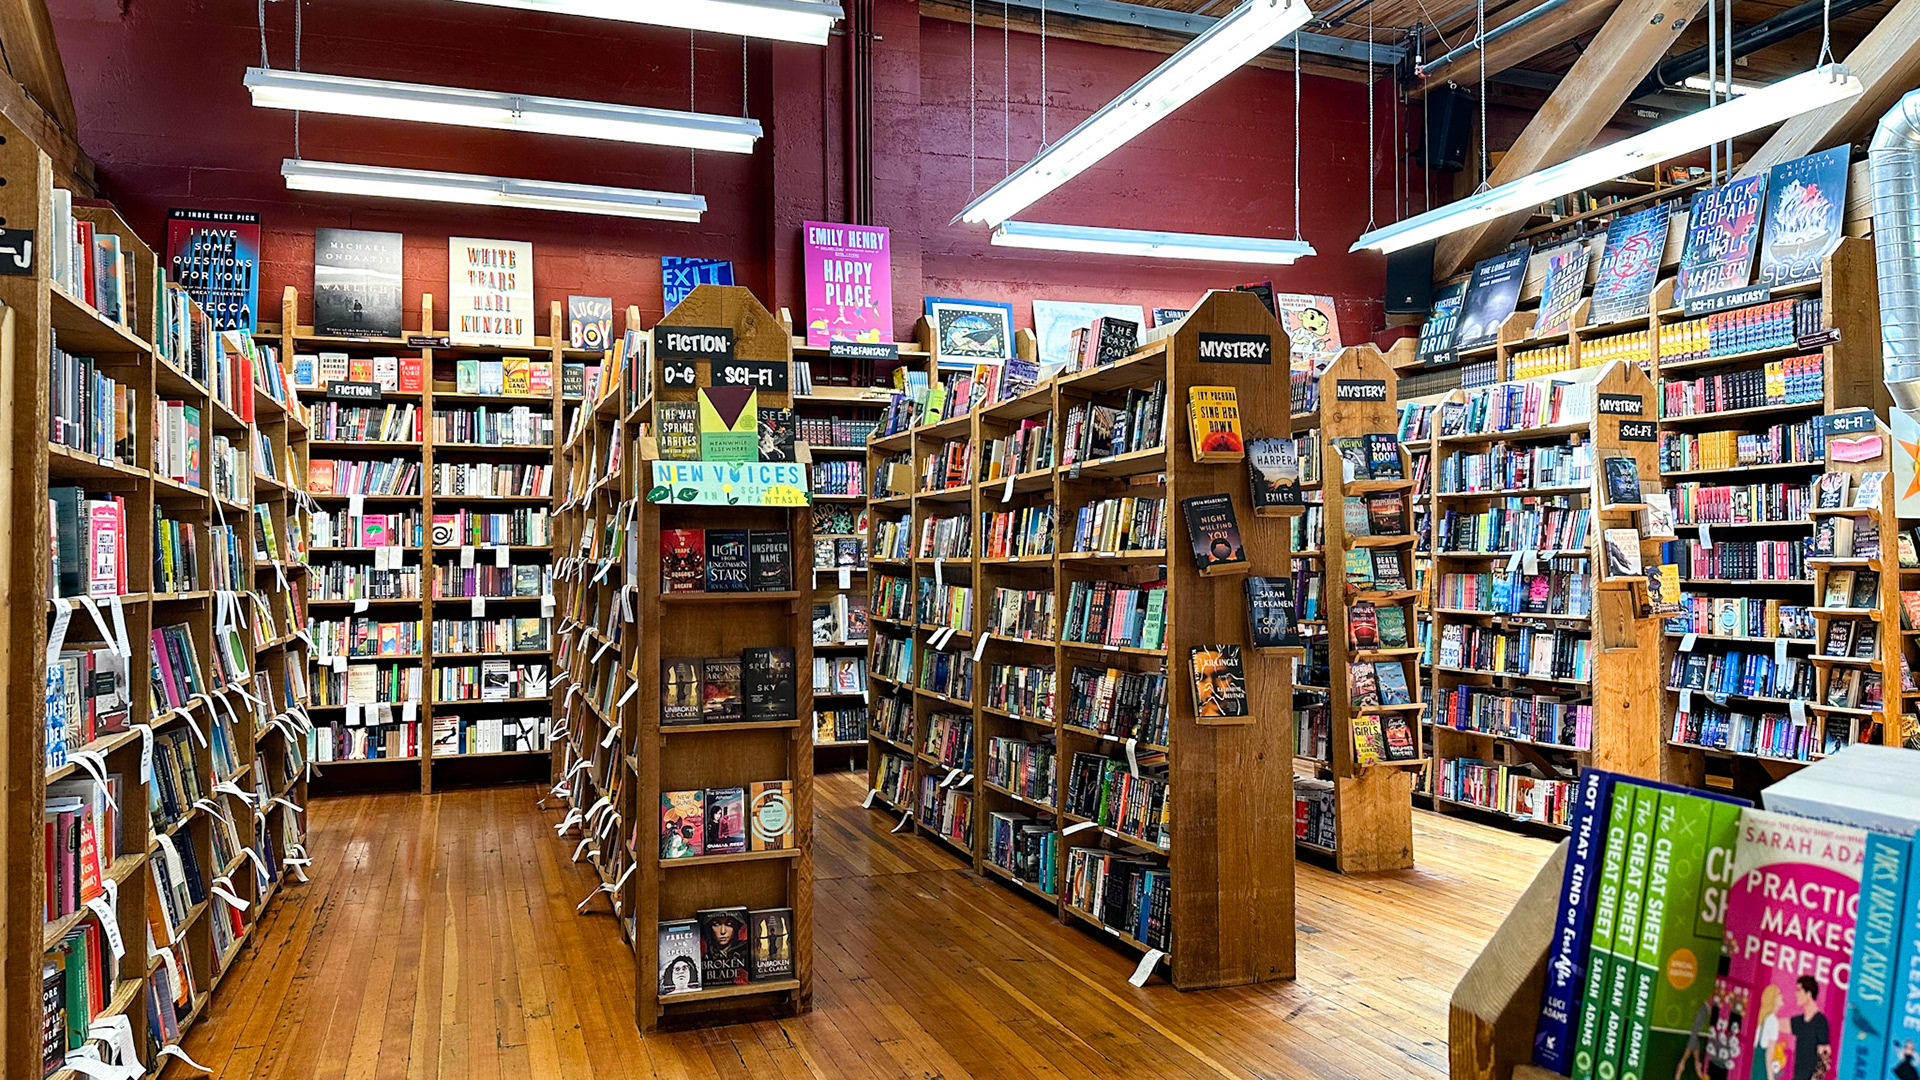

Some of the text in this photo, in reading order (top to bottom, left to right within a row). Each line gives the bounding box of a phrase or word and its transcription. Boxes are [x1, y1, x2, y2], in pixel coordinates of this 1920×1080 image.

[1786, 154, 1830, 170] NICOLA
[1779, 159, 1835, 179] GRIFFITH
[1705, 182, 1754, 211] BLACK
[188, 211, 210, 219] INDIE
[1690, 198, 1757, 230] LEOPARD
[190, 228, 238, 238] I HAVE
[809, 227, 884, 250] EMILY HENRY
[194, 242, 232, 252] SOME
[330, 242, 387, 252] MICHAEL
[1708, 233, 1747, 258] WOLF
[173, 255, 252, 268] QUESTIONS
[325, 253, 392, 264] ONDAATJE
[467, 247, 517, 269] WHITE
[1603, 244, 1660, 269] NOCTURNAL
[824, 259, 873, 285] HAPPY
[1480, 258, 1521, 276] THE LONG TAKE
[1556, 252, 1588, 282] PIRATE
[182, 270, 243, 281] FOR YOU
[663, 262, 728, 286] EXIT
[1688, 260, 1748, 288] MARLON
[467, 270, 516, 292] TEARS
[1552, 270, 1584, 298] CINEMA
[321, 283, 398, 294] WARLIGHT
[825, 282, 873, 308] PLACE
[473, 295, 512, 313] HARI
[1434, 296, 1462, 309] EXISTENCE
[1691, 289, 1765, 312] SCI-FI & FANTASY
[570, 301, 611, 319] LUCKY
[460, 315, 523, 336] KUNZRU
[1111, 325, 1132, 336] THE
[1421, 316, 1457, 339] DAVID
[571, 319, 612, 349] BOY
[667, 333, 727, 353] FICTION
[1106, 334, 1132, 348] LAST
[1420, 334, 1450, 355] BRIN
[1106, 346, 1129, 357] ONE
[1200, 340, 1267, 359] MYSTERY
[1433, 352, 1451, 363] SCI-FI
[664, 366, 695, 384] D-G
[724, 366, 773, 387] SCI-FI
[335, 385, 373, 396] FICTION
[1198, 391, 1208, 401] IVY
[1337, 385, 1385, 398] MYSTERY
[1200, 406, 1238, 419] SING HER
[1599, 399, 1641, 413] MYSTERY
[660, 409, 696, 420] THE WAY
[761, 410, 792, 420] SEEP
[663, 422, 694, 433] SPRING
[1209, 421, 1233, 433] DOWN
[1833, 416, 1864, 430] SCI-FI
[1622, 425, 1651, 437] Sci-Fi
[661, 434, 697, 447] ARRIVES
[1371, 442, 1397, 452] SPARE
[1262, 443, 1285, 454] JANE
[1257, 455, 1292, 466] HARPER
[1372, 451, 1398, 461] ROOM
[658, 465, 799, 484] NEW VOICES
[704, 486, 780, 500] IN SCI-FI
[1266, 492, 1294, 503] EXILES
[748, 496, 799, 505] FANTASY
[1191, 499, 1204, 507] JULIA
[1201, 514, 1226, 524] NIGHT
[1208, 531, 1228, 540] YOU
[712, 544, 745, 557] LIGHT
[752, 543, 788, 554] UNSPOKEN
[760, 554, 780, 563] NAME
[710, 568, 747, 582] STARS
[1253, 600, 1294, 608] PEKKANEN
[1262, 617, 1289, 625] GONE
[1257, 626, 1297, 635] TONIGHT
[1443, 624, 1461, 633] RUTH
[1442, 633, 1461, 642] WARE
[1440, 648, 1459, 657] ZERO
[749, 662, 791, 670] SPLINTER
[1204, 658, 1239, 667] KILLINGLY
[1440, 657, 1457, 667] DAYS
[757, 684, 776, 692] SKY
[1355, 726, 1379, 736] GIRLS
[1585, 774, 1600, 810] NOT
[1577, 814, 1593, 860] THAT
[1746, 826, 1812, 855] SARAH
[1596, 795, 1628, 939] The CHEAT SHEET
[1618, 800, 1650, 946] The CHEAT SHEET
[1568, 863, 1585, 906] KIND
[1642, 805, 1675, 956] The CHEAT SHEET
[1567, 908, 1577, 926] OF
[666, 933, 693, 941] FABLES
[1760, 906, 1857, 955] MAKES
[667, 948, 693, 956] SPELLS
[701, 959, 745, 970] BROKEN
[706, 969, 740, 979] BLADE
[1548, 996, 1566, 1010] LUCI
[1581, 957, 1603, 1047] SARAH ADAMS
[1543, 1007, 1567, 1024] ADAMS
[1604, 964, 1627, 1057] SARAH ADAMS
[1628, 974, 1651, 1068] SARAH ADAMS
